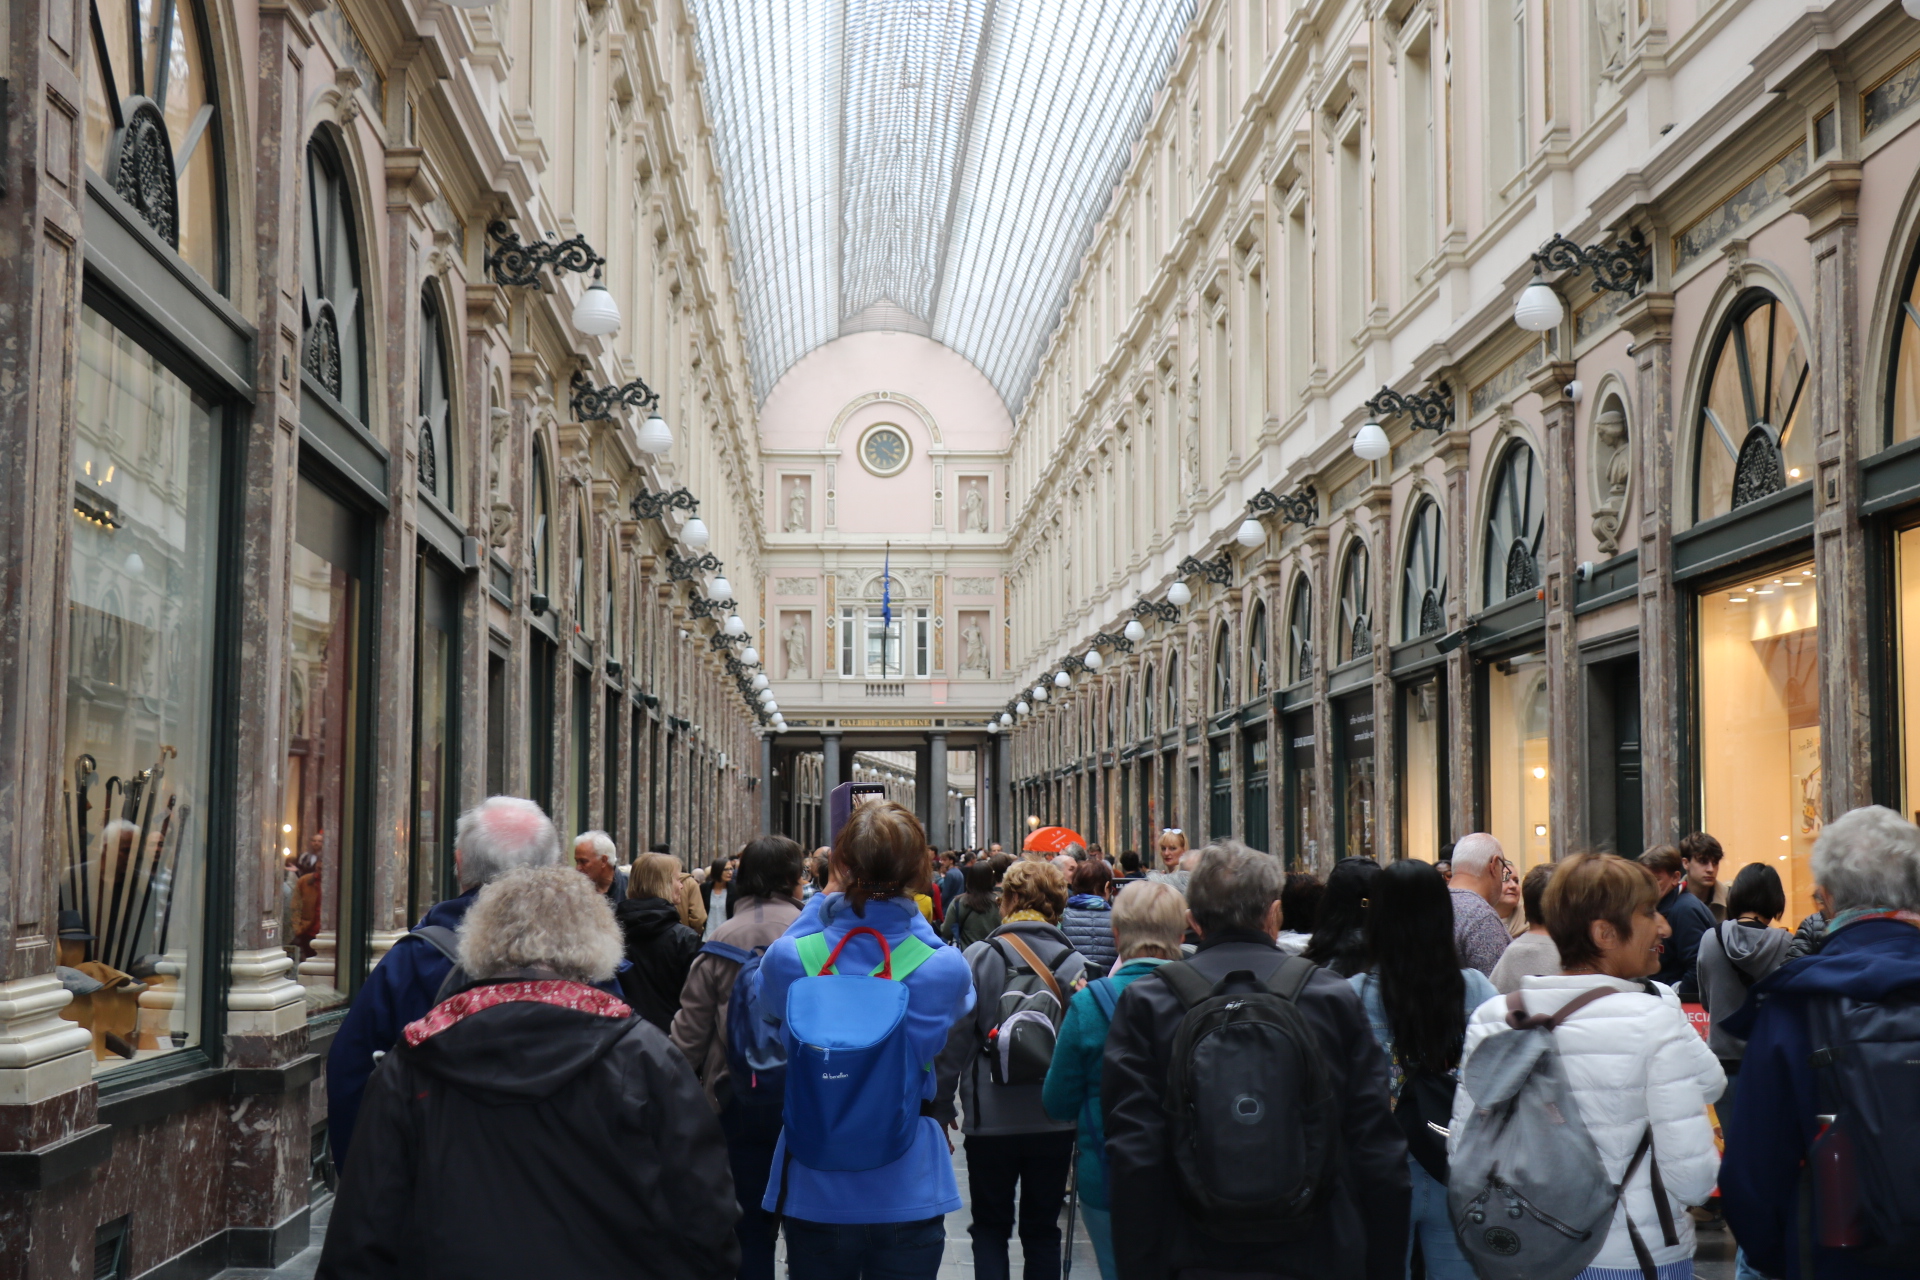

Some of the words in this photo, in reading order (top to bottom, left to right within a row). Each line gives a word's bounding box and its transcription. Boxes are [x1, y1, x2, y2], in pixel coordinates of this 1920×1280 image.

[840, 718, 876, 727] GALERIE
[878, 718, 890, 727] DE
[891, 718, 903, 727] LA
[903, 718, 931, 727] REINE
